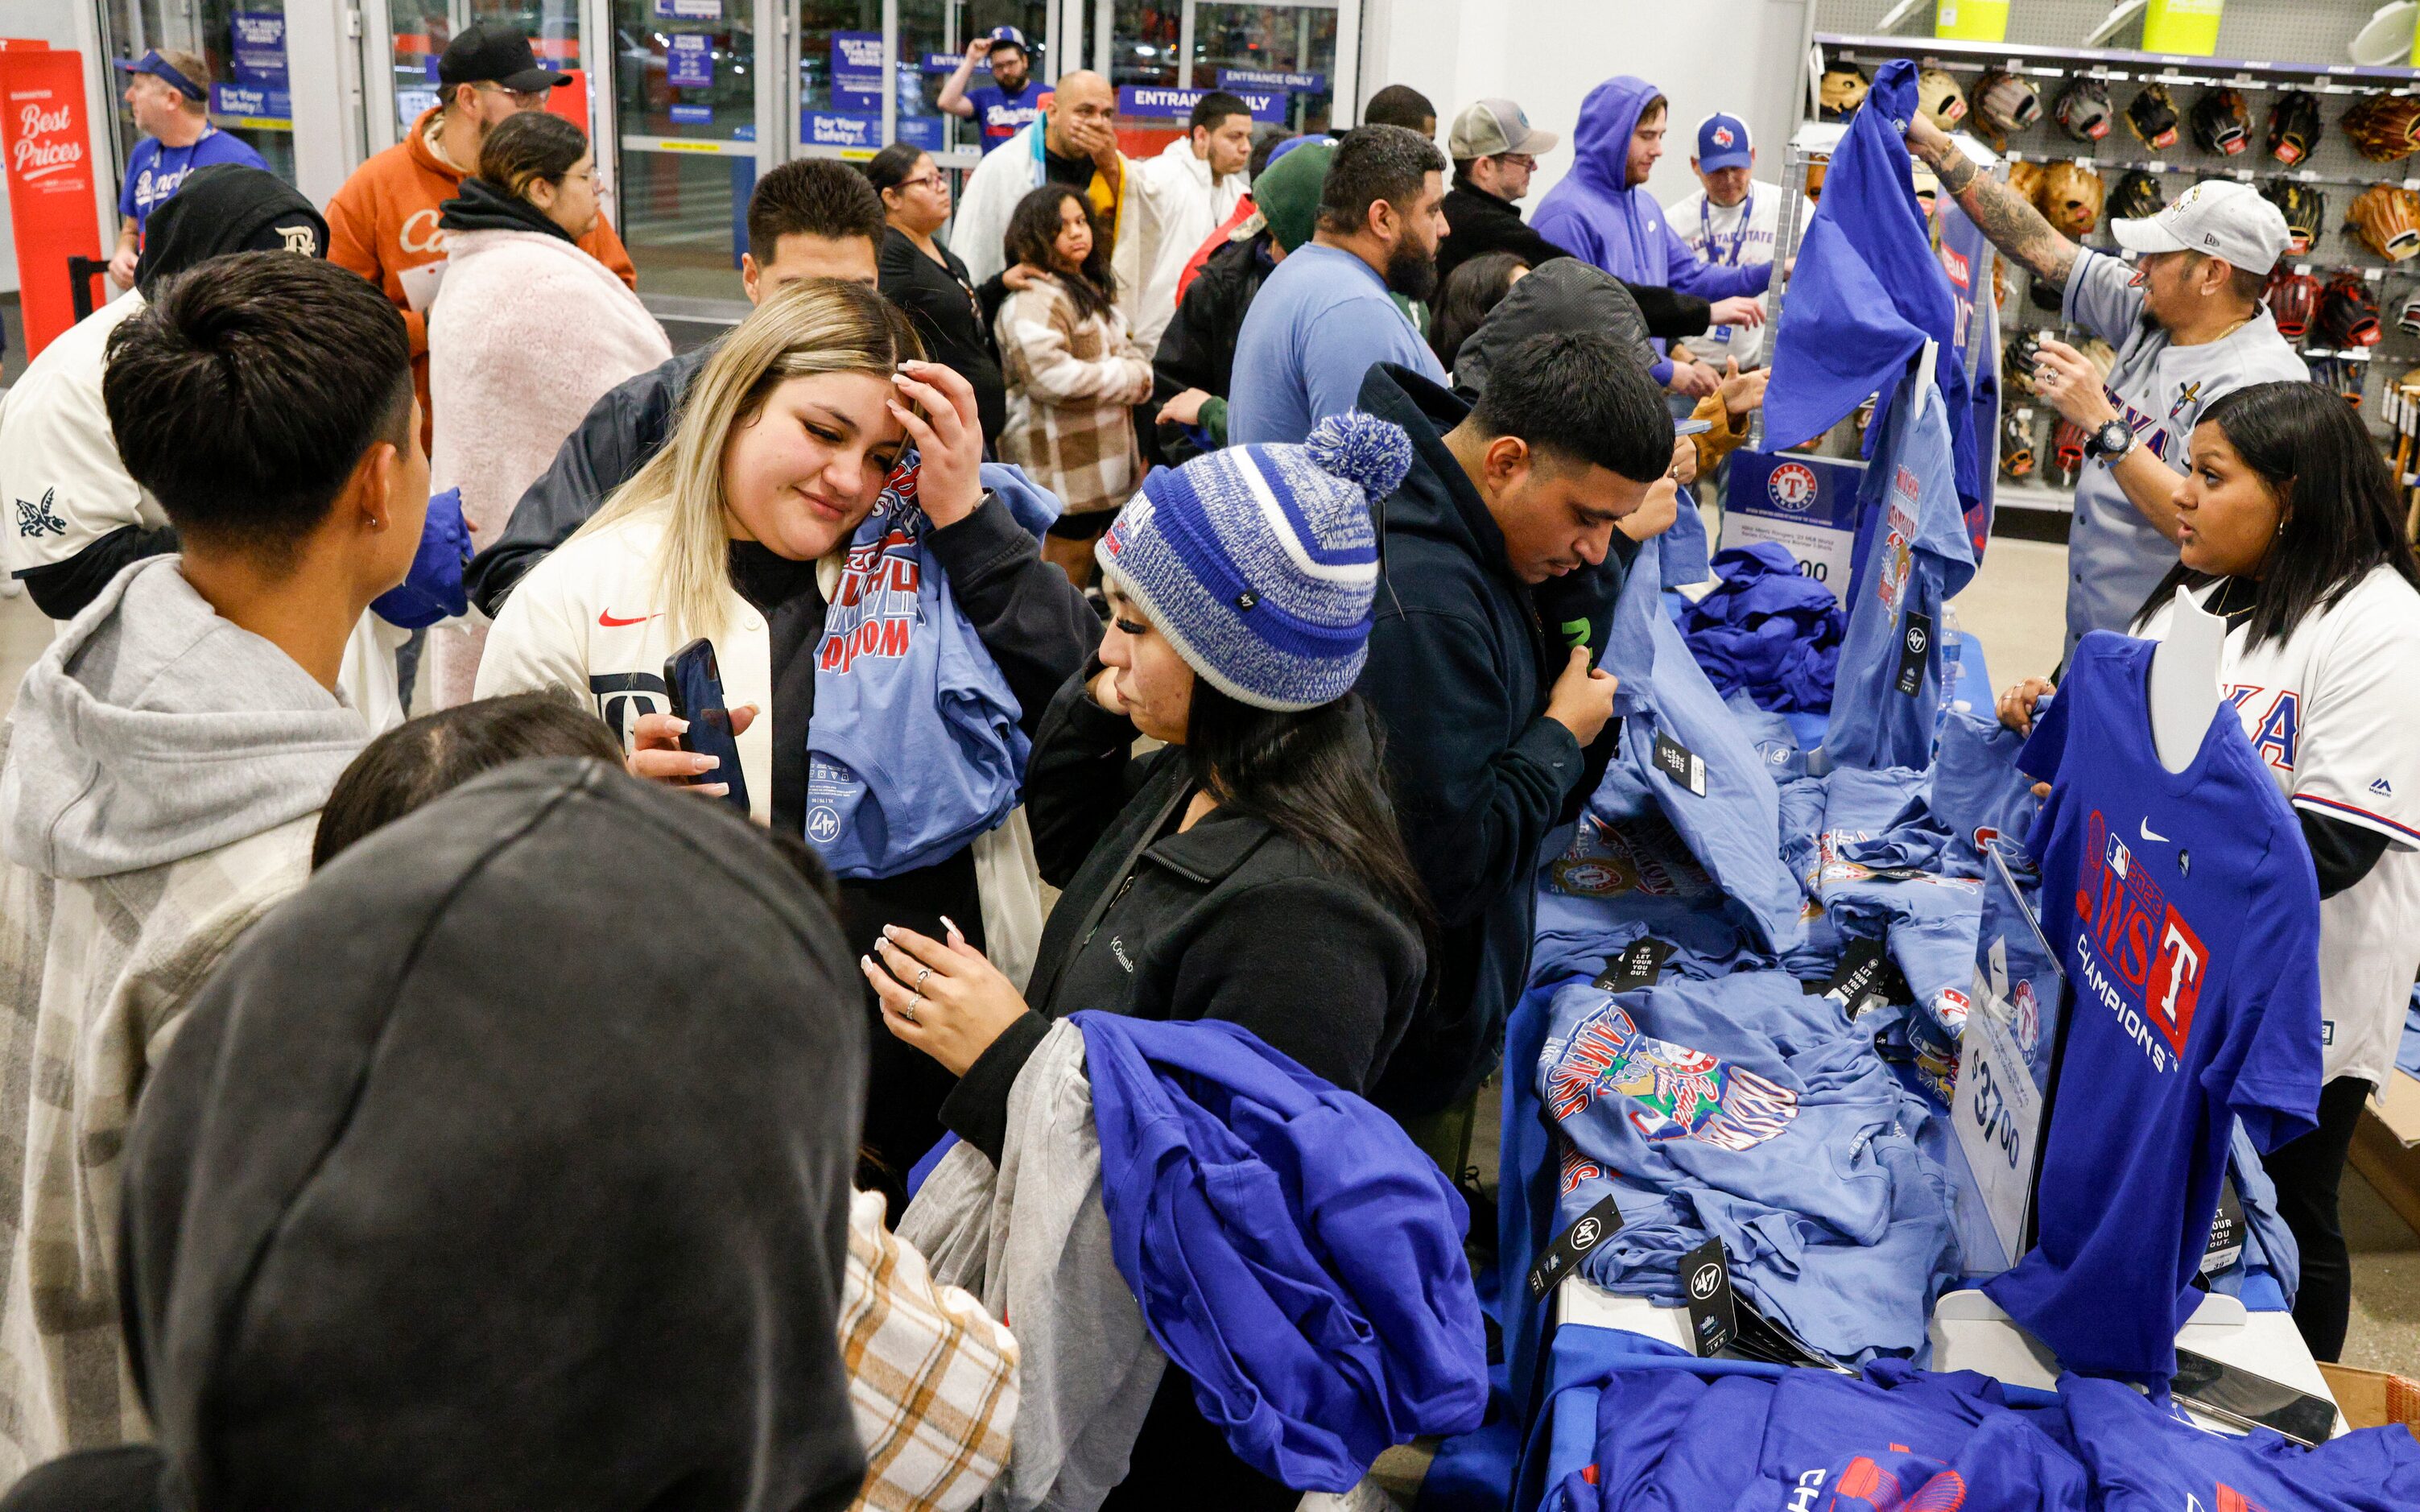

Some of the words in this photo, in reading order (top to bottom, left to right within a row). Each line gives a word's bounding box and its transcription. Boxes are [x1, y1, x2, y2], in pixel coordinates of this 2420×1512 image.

[849, 57, 882, 67] MORE
[1226, 71, 1284, 85] ENTRANCE
[1285, 74, 1314, 86] ONLY
[1134, 89, 1204, 108] ENTRAN
[20, 103, 71, 139] Best
[814, 115, 834, 130] For
[835, 117, 867, 133] Your
[814, 129, 855, 146] Safety
[14, 138, 83, 171] Prices
[1784, 477, 1803, 498] T
[817, 617, 911, 676] World
[2368, 787, 2392, 799] Majestic
[2126, 862, 2163, 916] 2023
[2096, 864, 2154, 986] WS
[1113, 940, 1134, 973] Columb
[1852, 970, 1869, 986] YOUR
[1859, 965, 1873, 977] LET
[2161, 922, 2199, 1023] T
[1840, 984, 1855, 998] OUT.
[1848, 977, 1860, 990] YOU
[2077, 933, 2167, 1073] CHAMPIONS
[2212, 1218, 2232, 1230] OUR
[2209, 1238, 2230, 1249] OUT.
[2210, 1229, 2230, 1241] YOU
[1695, 1268, 1718, 1293] '47
